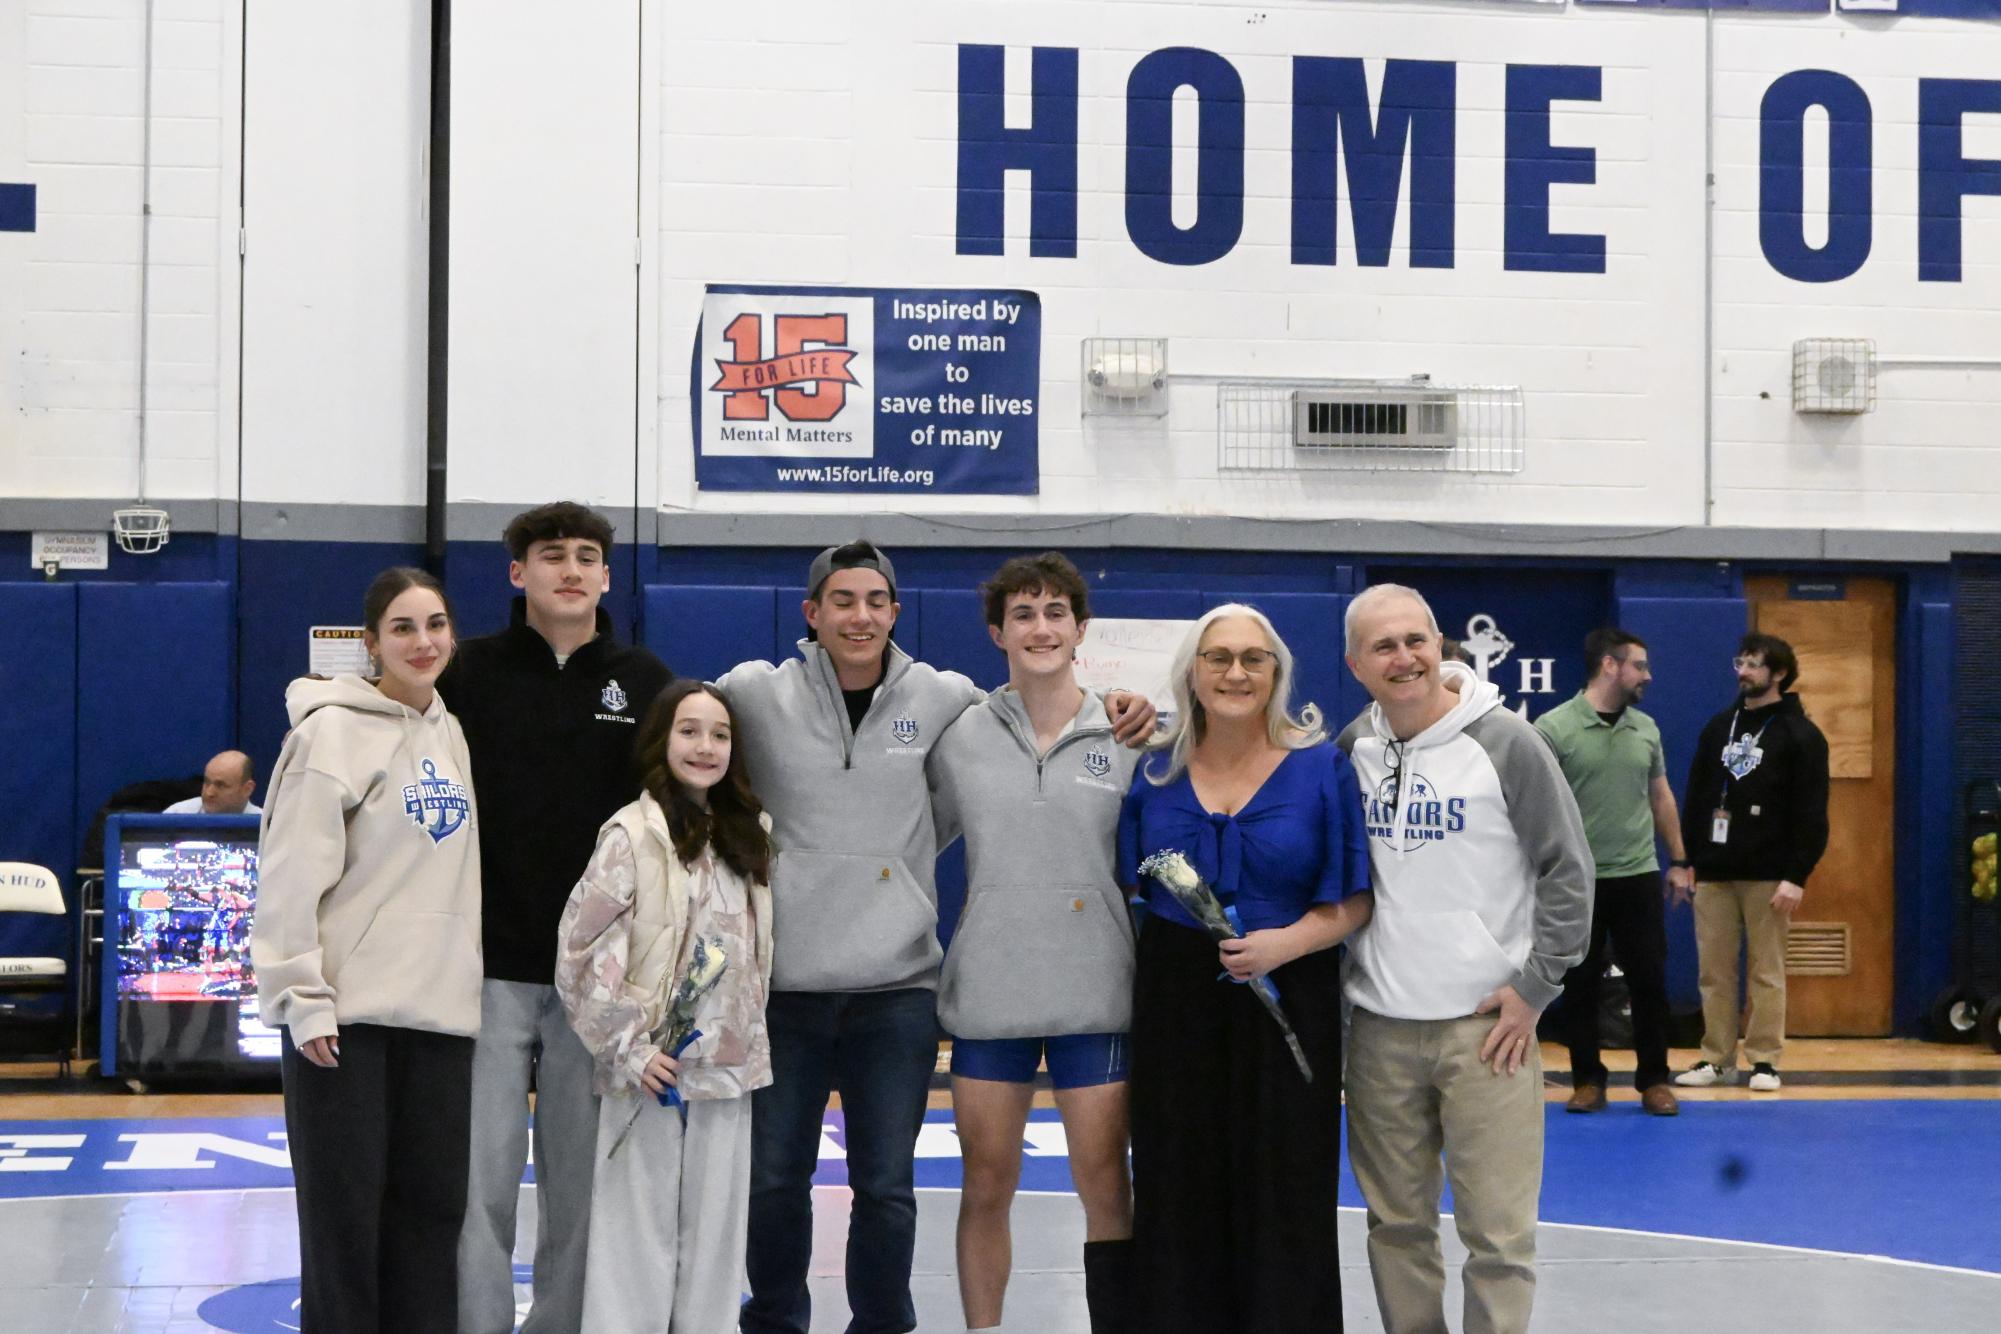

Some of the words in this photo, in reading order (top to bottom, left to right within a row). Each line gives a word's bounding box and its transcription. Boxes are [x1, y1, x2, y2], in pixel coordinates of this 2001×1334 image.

[956, 43, 1606, 274] HOME
[1759, 68, 2001, 283] OF
[893, 298, 987, 324] Inspired
[993, 300, 1021, 324] by
[908, 334, 951, 352] one
[957, 334, 1006, 352] man
[723, 312, 848, 422] 15
[742, 366, 778, 386] FOR
[789, 356, 830, 377] LIFE
[945, 364, 969, 383] to
[880, 397, 932, 415] save
[938, 394, 975, 415] the
[981, 394, 1033, 415] lives
[720, 427, 780, 442] Mental
[786, 428, 853, 443] Matters
[910, 425, 936, 446] of
[940, 429, 1003, 450] many
[777, 465, 934, 486] www.15forLife.org
[43, 545, 97, 554] OCCUPANCY
[316, 630, 366, 638] CAUTIO
[1517, 658, 1556, 693] H
[1367, 826, 1445, 841] WRETLING
